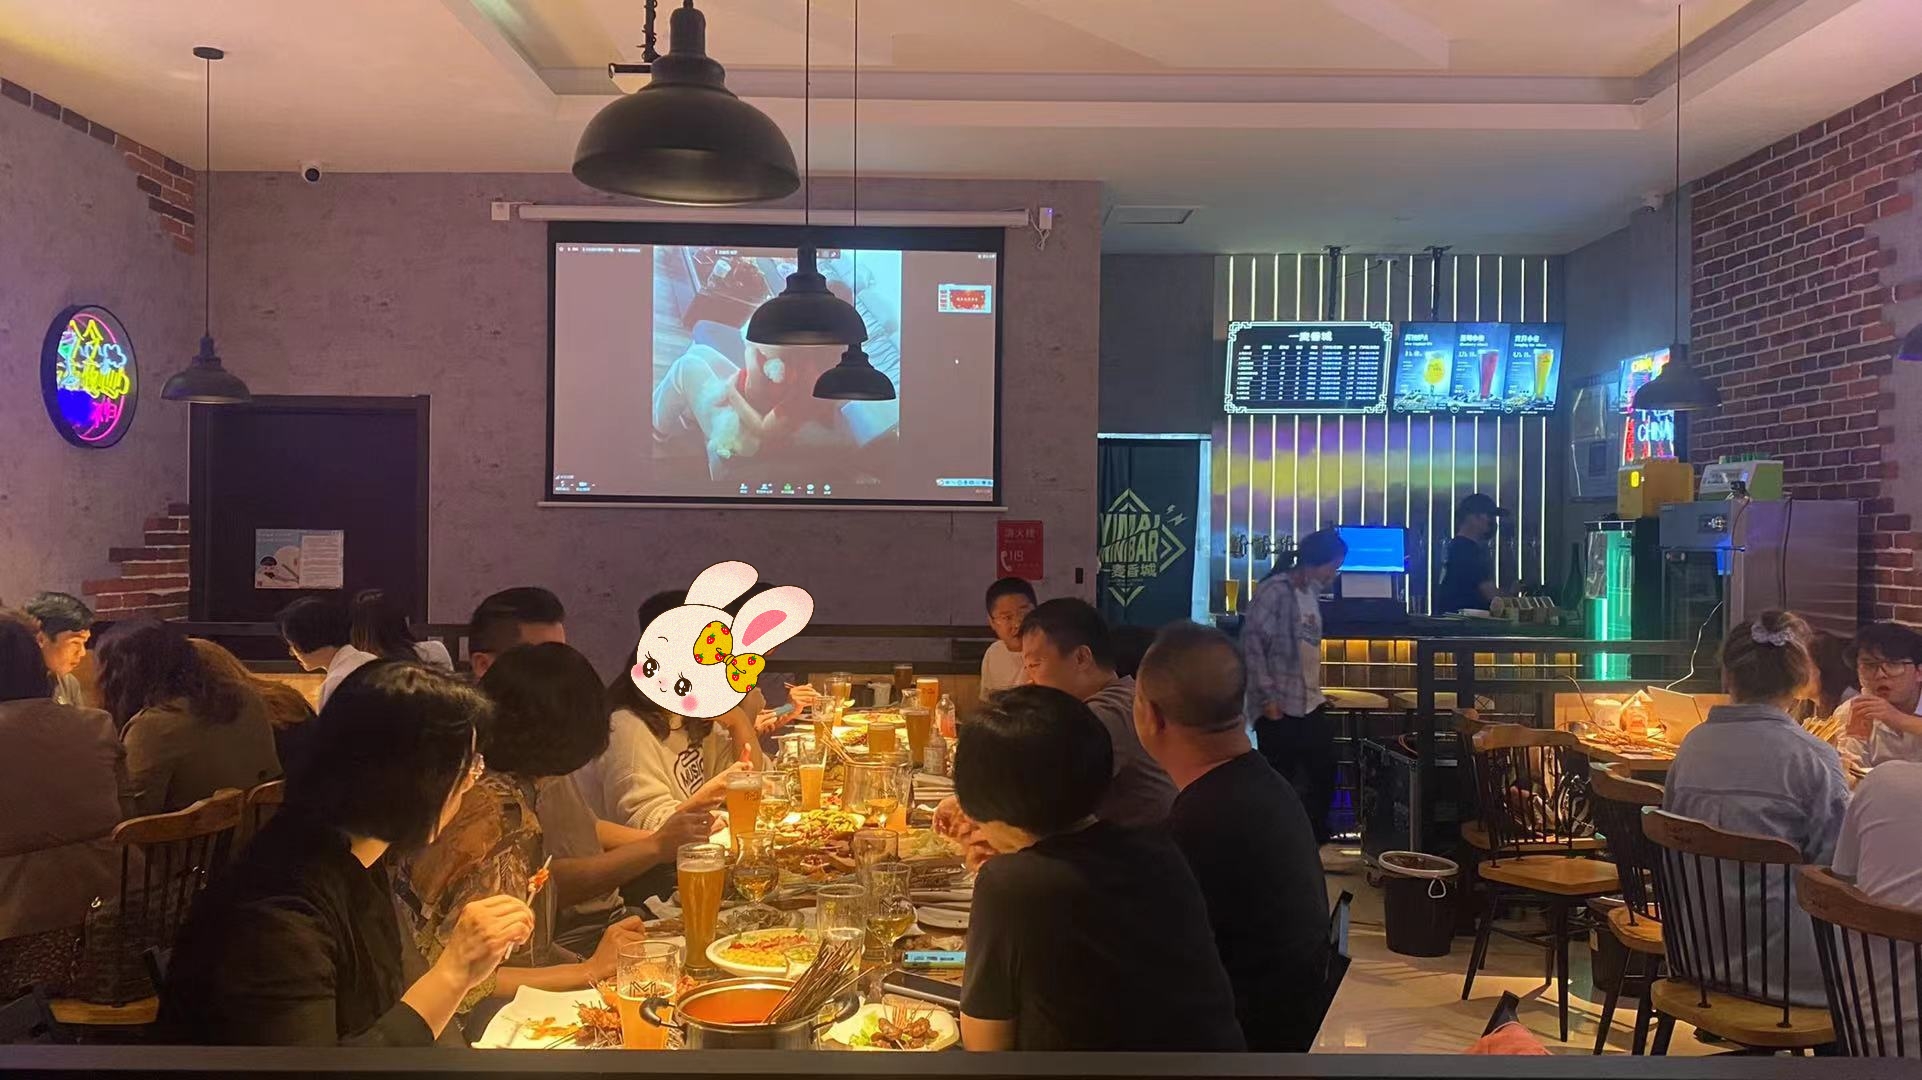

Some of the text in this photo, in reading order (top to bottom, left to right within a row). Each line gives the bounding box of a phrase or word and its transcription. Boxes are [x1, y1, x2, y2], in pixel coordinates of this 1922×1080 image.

[1009, 550, 1024, 562] 119
[1100, 563, 1157, 578] 一麦香城
